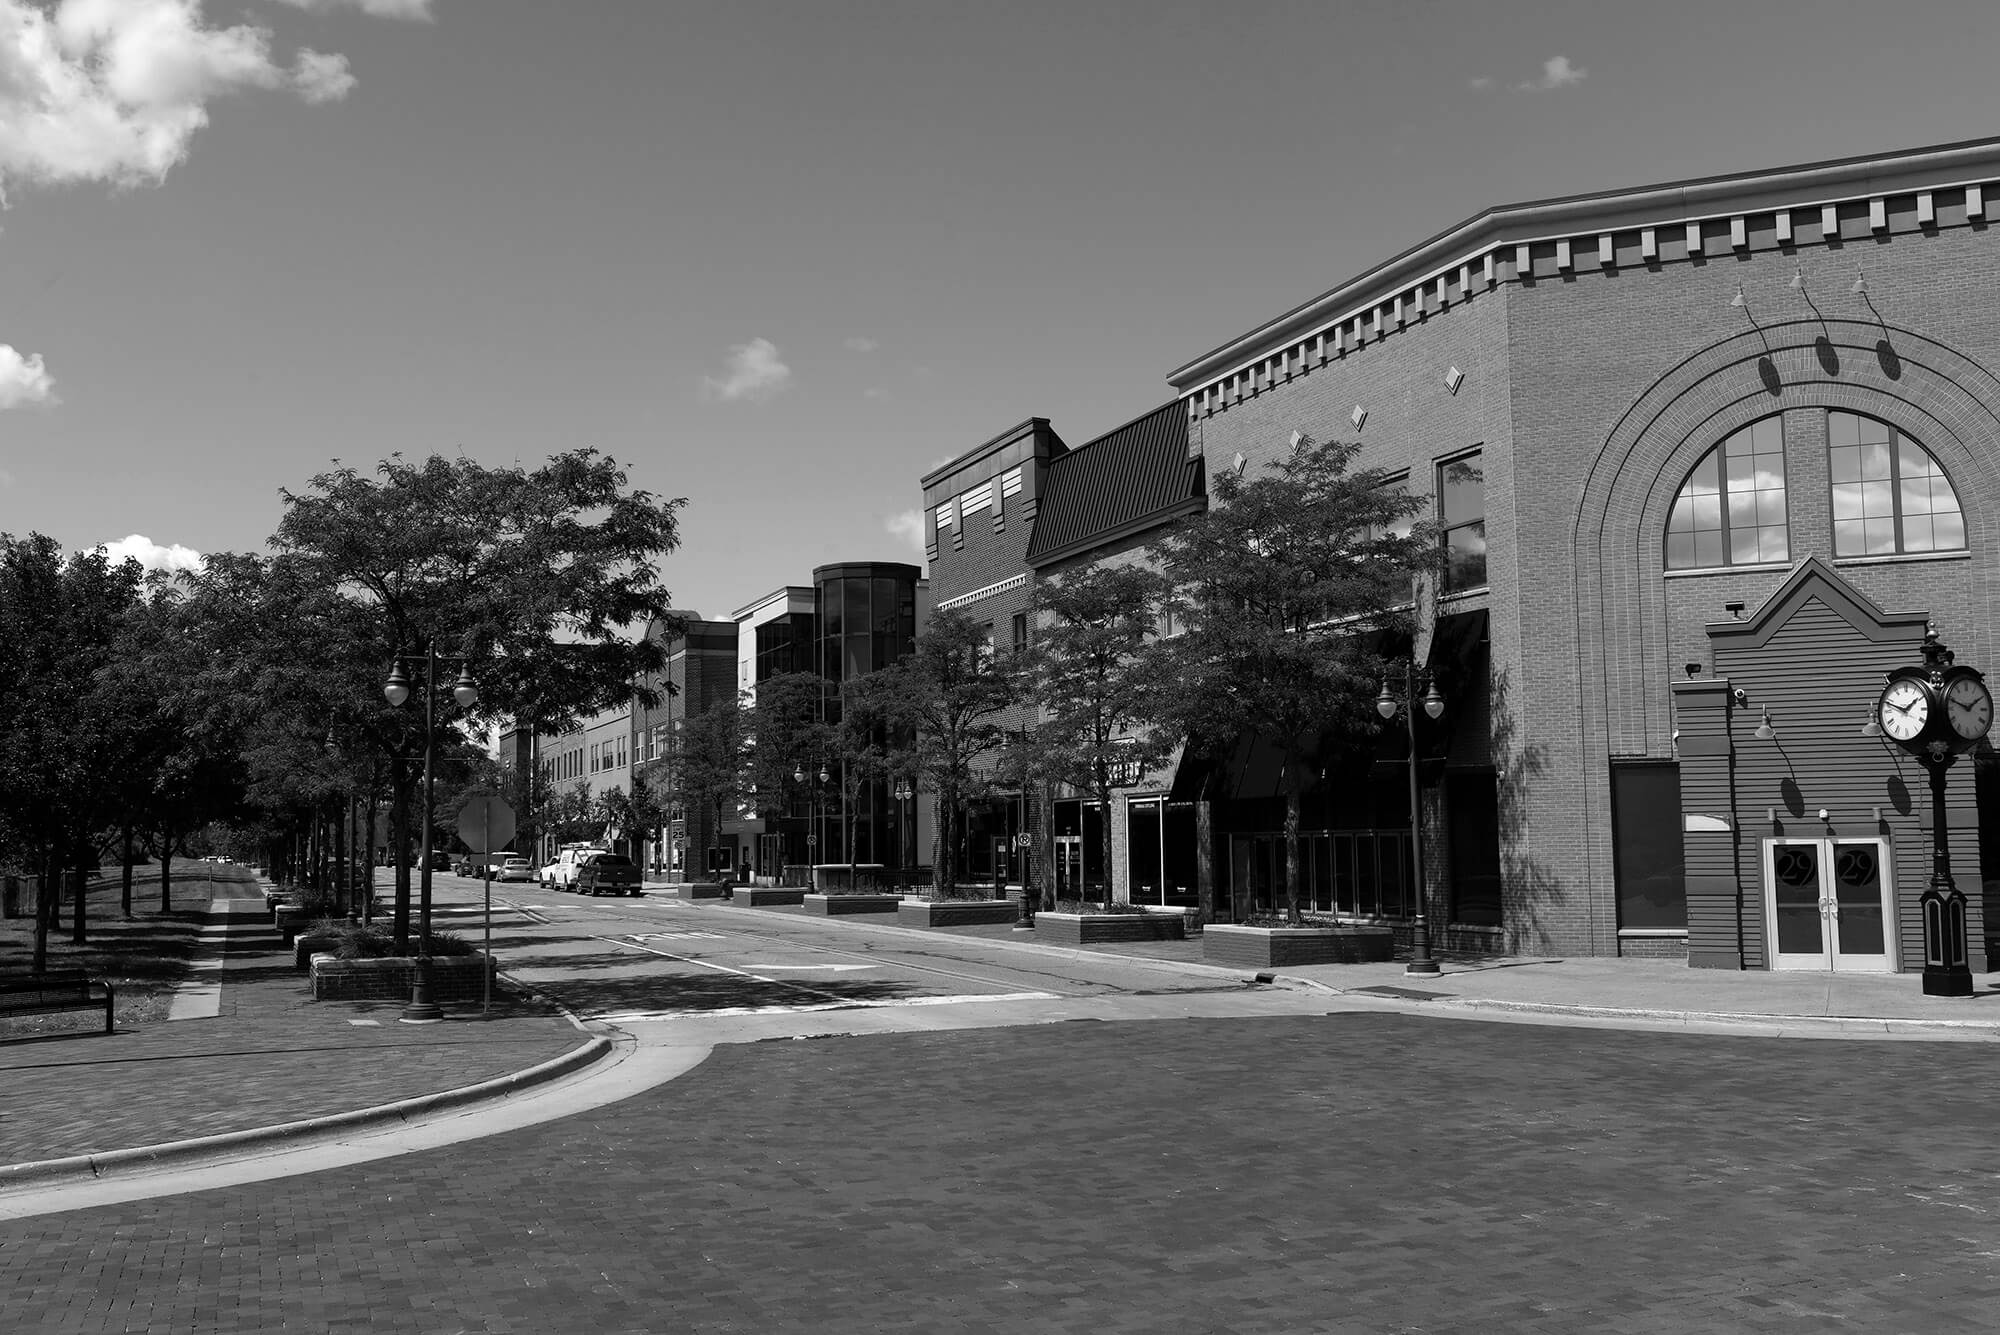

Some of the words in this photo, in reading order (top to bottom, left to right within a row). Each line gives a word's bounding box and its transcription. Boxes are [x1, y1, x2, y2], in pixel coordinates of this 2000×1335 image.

[673, 831, 684, 839] 25
[1781, 853, 1815, 887] 29
[1840, 853, 1875, 887] 29
